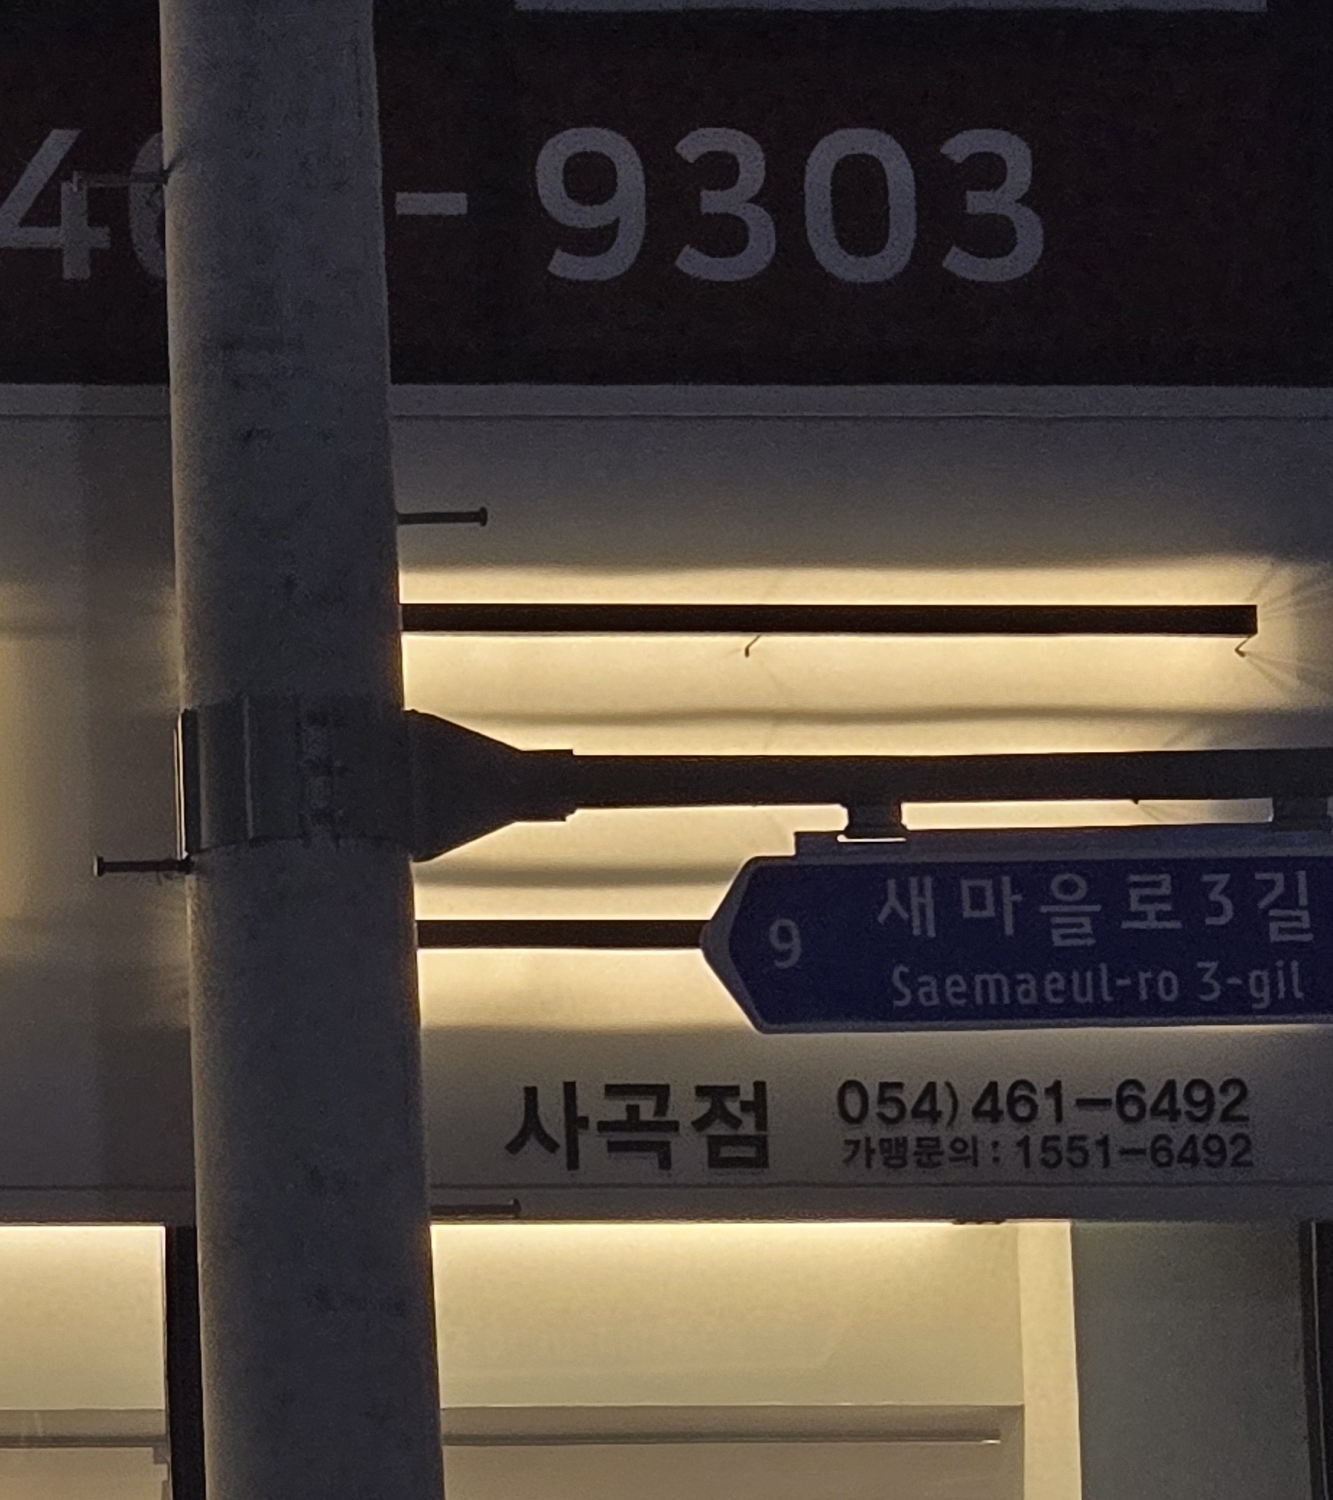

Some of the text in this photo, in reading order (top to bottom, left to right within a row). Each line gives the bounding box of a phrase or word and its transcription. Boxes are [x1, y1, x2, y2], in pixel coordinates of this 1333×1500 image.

[768, 918, 802, 968] 9
[891, 959, 1305, 1012] Saemaeul-ro 3-gil
[504, 1079, 771, 1171] 사곡점
[837, 1078, 1250, 1127] 054)461-6492
[1015, 1134, 1254, 1169] 1551-6492
